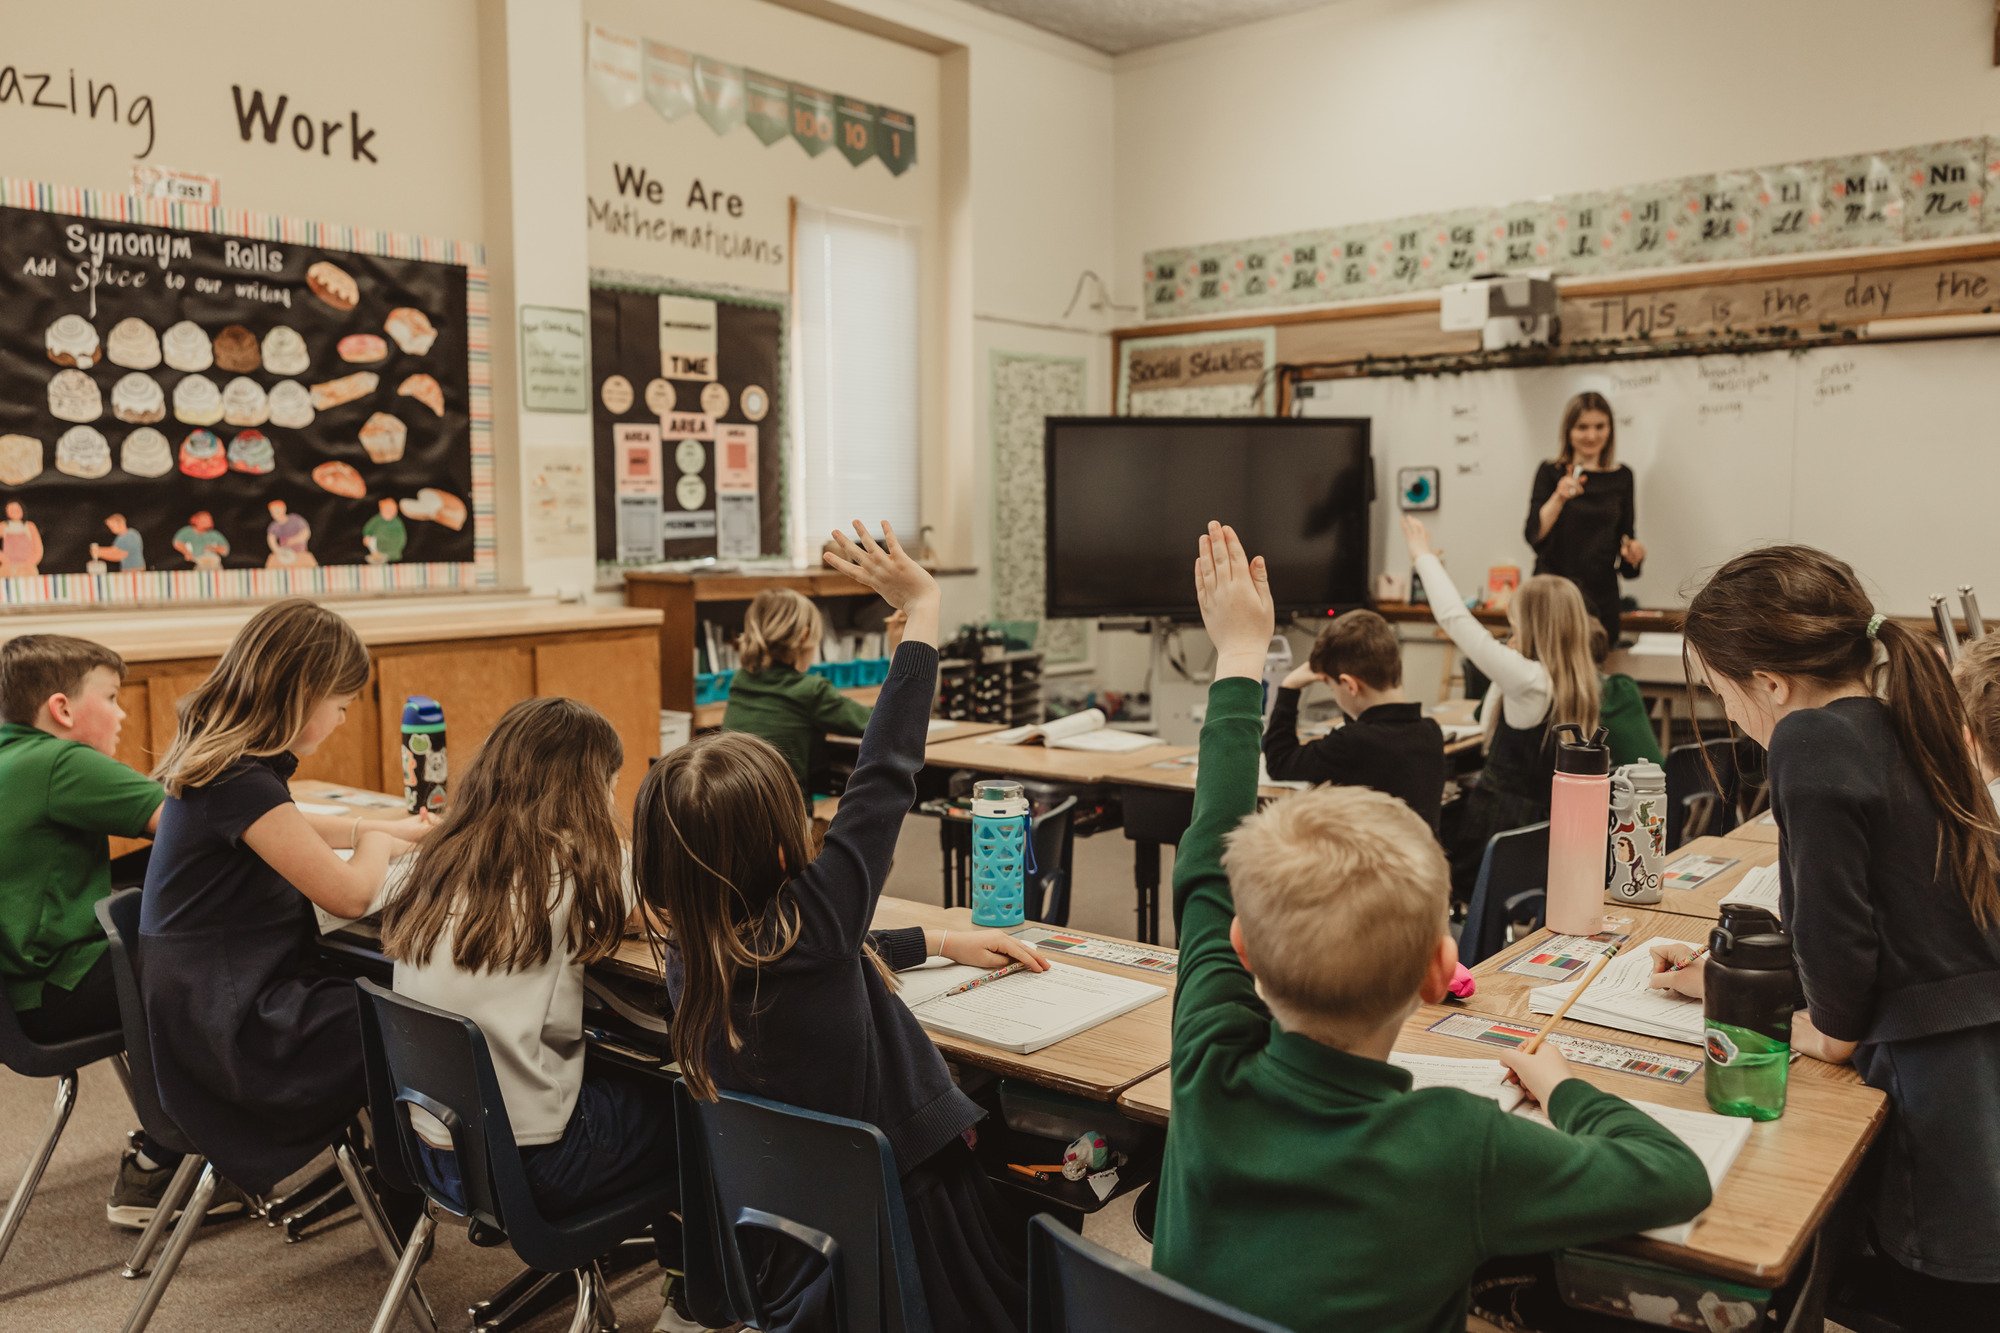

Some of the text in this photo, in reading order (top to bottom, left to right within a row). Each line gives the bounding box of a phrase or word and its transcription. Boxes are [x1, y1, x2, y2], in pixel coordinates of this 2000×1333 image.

[231, 84, 378, 164] Work
[795, 109, 834, 141] 100
[844, 121, 868, 151] 10
[613, 162, 744, 219] We Are
[1930, 163, 1966, 185] Nn
[65, 223, 284, 273] Synonym Rolls
[587, 195, 784, 265] Mathematicians
[22, 256, 292, 319] Add Spice to our writing
[1589, 272, 1990, 334] This is the day the
[671, 356, 709, 376] TIME
[1129, 347, 1265, 384] Social Studies
[624, 431, 651, 442] AREA
[669, 418, 707, 433] AREA
